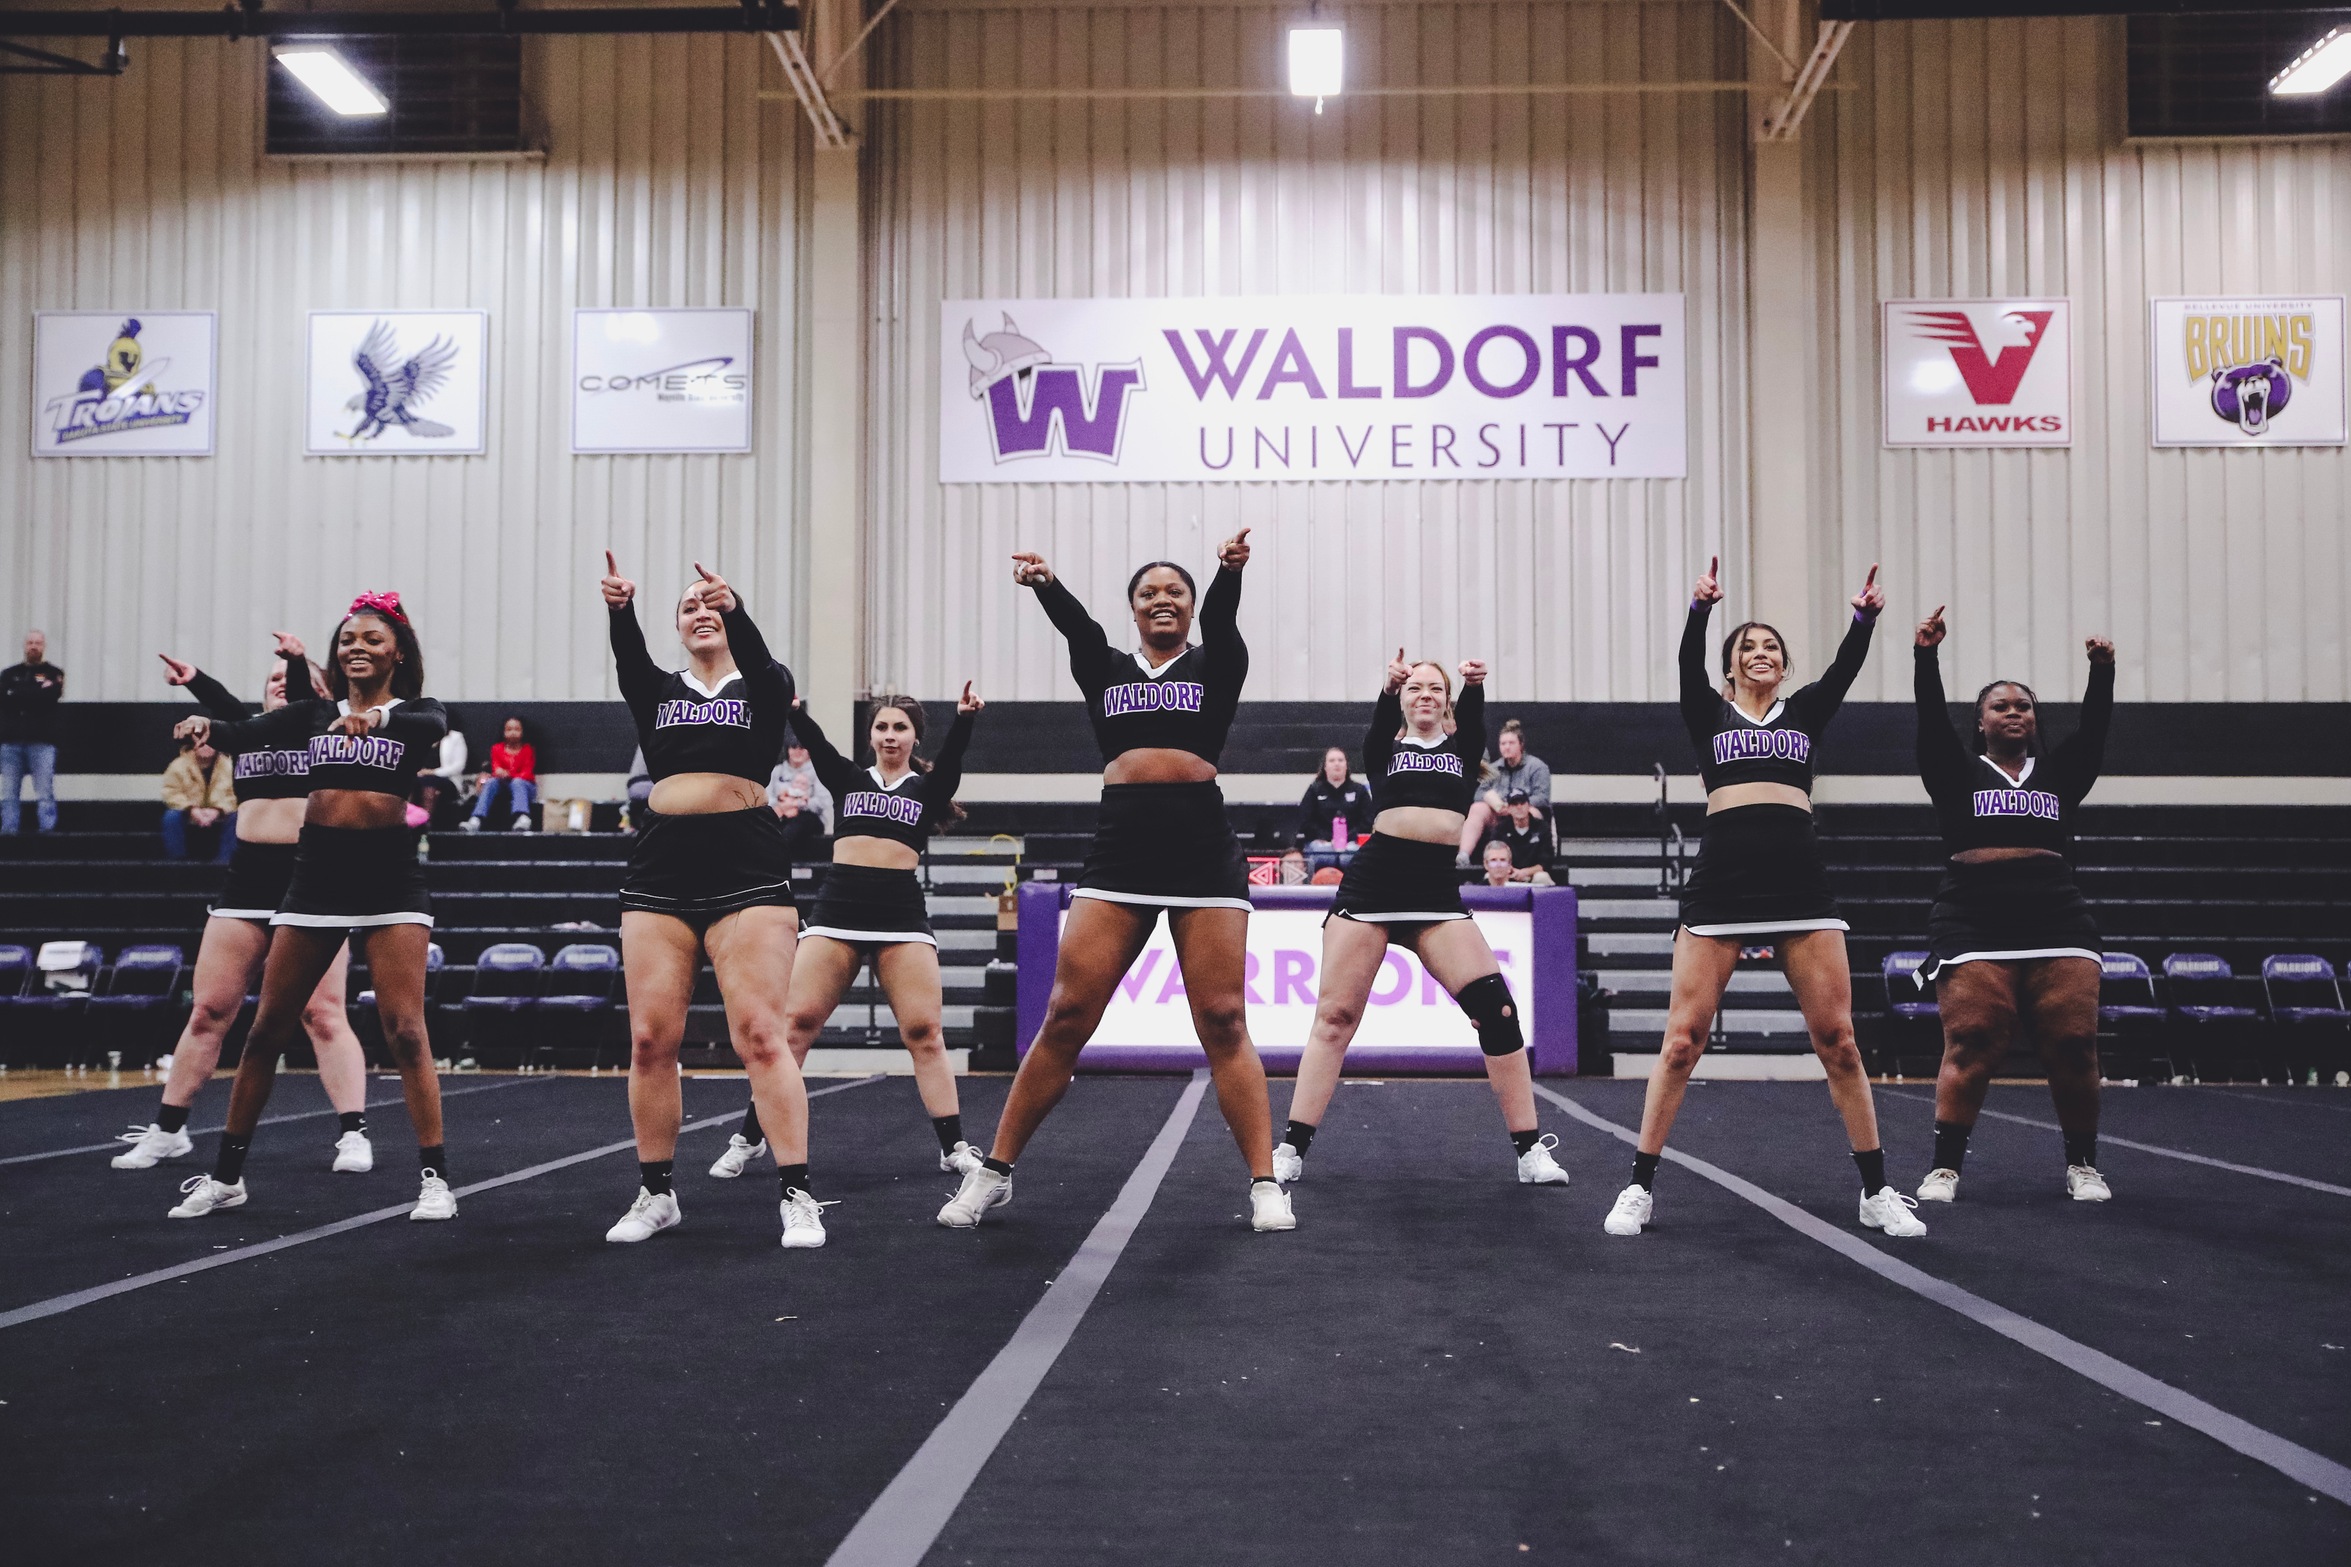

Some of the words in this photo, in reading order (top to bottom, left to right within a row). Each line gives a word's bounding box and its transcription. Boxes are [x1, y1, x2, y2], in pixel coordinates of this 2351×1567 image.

[1161, 323, 1662, 401] WALDORF
[2184, 313, 2316, 387] BRUINS
[45, 388, 205, 432] TROJANS
[983, 357, 1147, 466] W
[1926, 415, 2062, 433] HAWKS
[1199, 422, 1632, 470] UNIVERSITY
[656, 699, 753, 730] WALDORF
[1104, 681, 1204, 718] WALDORF
[234, 750, 309, 780] WALDORF
[309, 734, 405, 771] WALDORF
[1387, 751, 1463, 778] WALDORF
[1713, 729, 1810, 765] WALDORF
[844, 791, 923, 826] WALDORF
[1973, 789, 2059, 821] WALDORF
[1108, 948, 1517, 1006] WARRO
